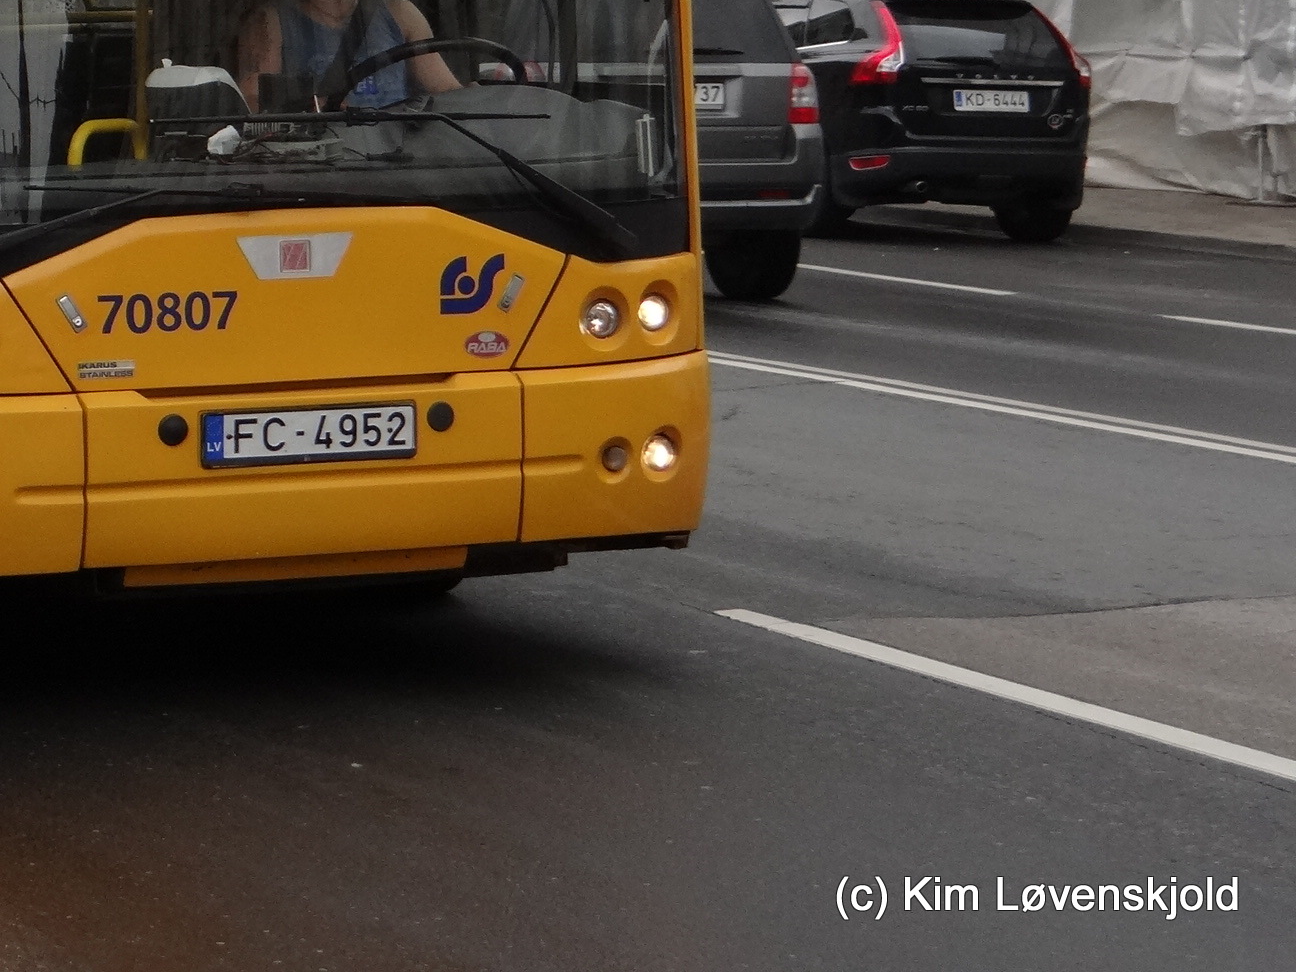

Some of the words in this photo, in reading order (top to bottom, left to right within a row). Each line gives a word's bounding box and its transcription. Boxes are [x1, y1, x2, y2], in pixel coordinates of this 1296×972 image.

[694, 85, 721, 103] 37
[965, 92, 1025, 108] KD-6444
[97, 290, 238, 335] 70807
[78, 361, 118, 370] IKARUS
[79, 369, 134, 379] STAINLESS
[206, 441, 222, 453] LV
[233, 411, 408, 454] FC-4952
